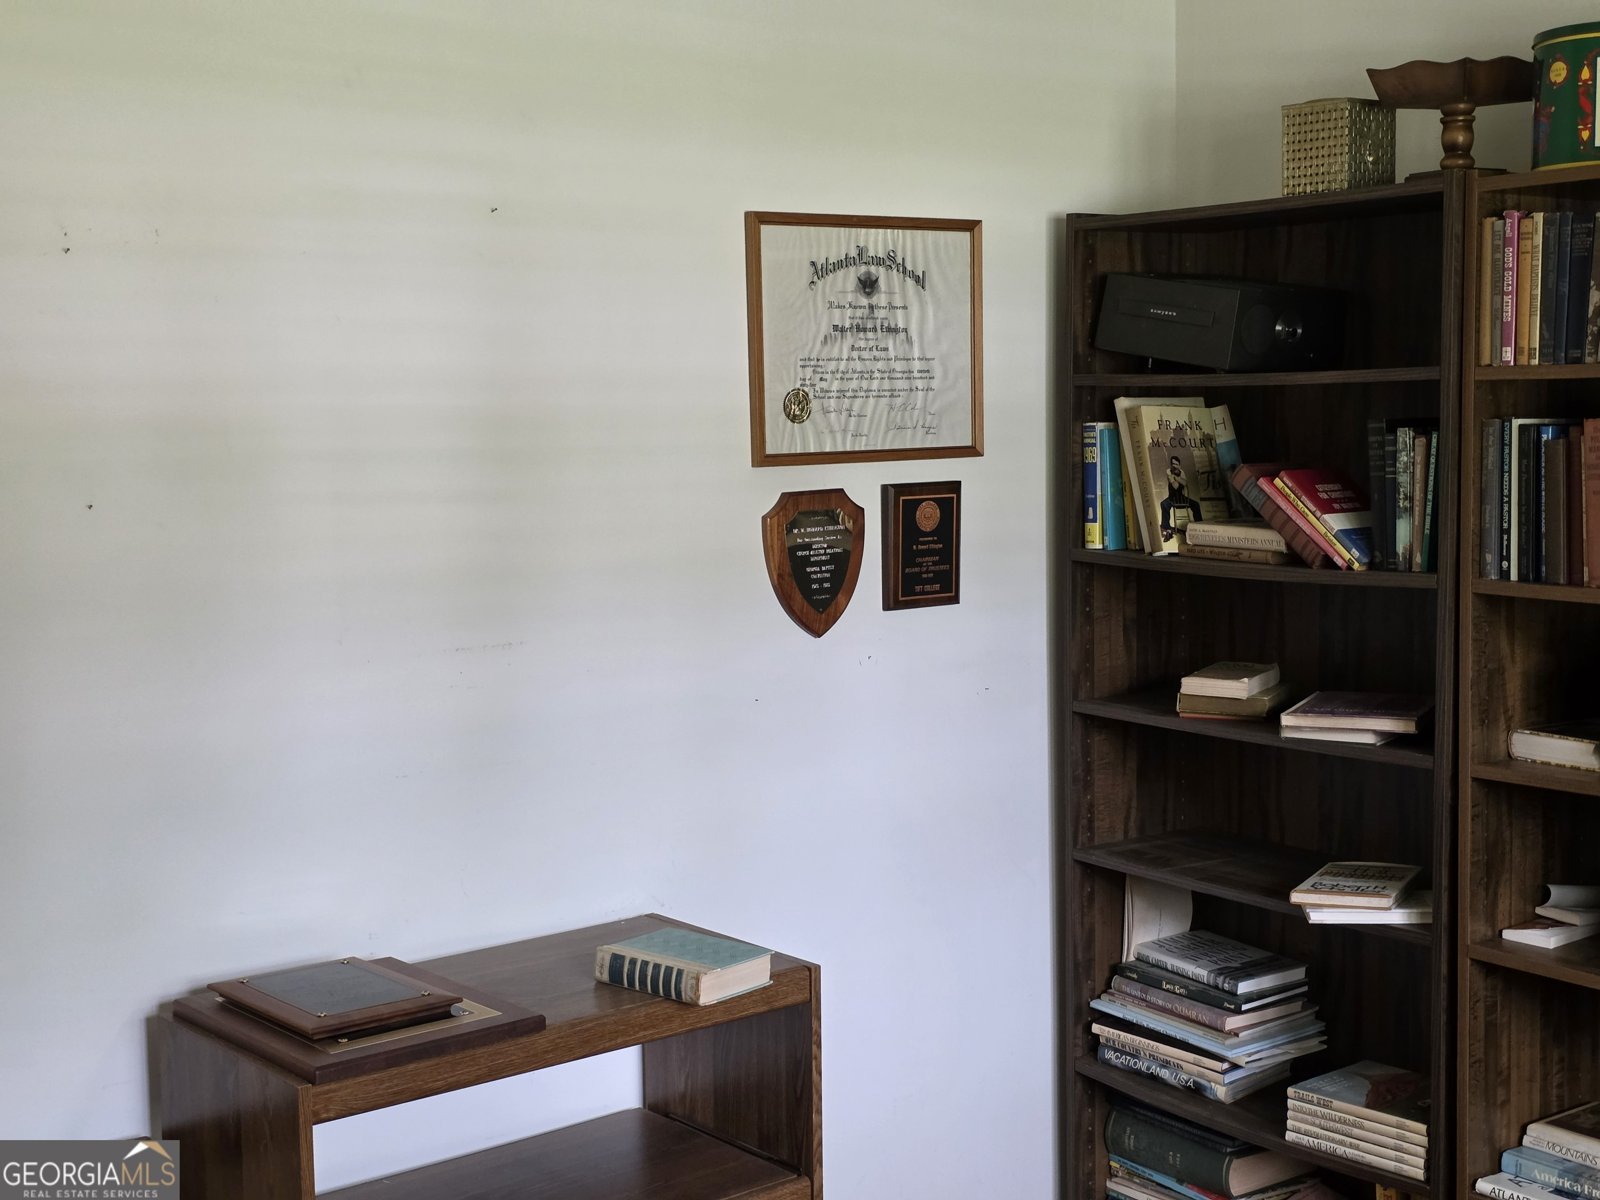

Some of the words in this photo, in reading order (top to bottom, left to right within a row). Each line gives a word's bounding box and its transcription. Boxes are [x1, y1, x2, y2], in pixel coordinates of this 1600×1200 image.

[808, 252, 857, 291] Atlanta
[855, 244, 886, 268] Law
[885, 249, 927, 291] School
[1504, 247, 1513, 268] GOD'S
[1503, 271, 1512, 292] GOLD
[1502, 295, 1512, 322] MINES
[1157, 418, 1203, 431] FRANK
[1151, 436, 1217, 449] McCOURT
[1430, 434, 1438, 455] GREAT
[1084, 446, 1097, 463] 1969
[1427, 456, 1435, 491] QUESTIONS
[1280, 484, 1294, 497] People
[1151, 996, 1165, 1006] STORY
[1172, 1003, 1210, 1024] QUMRAN
[1104, 1048, 1169, 1079] VACATIONLAND
[1172, 1072, 1196, 1090] U.S.A.
[1294, 1090, 1315, 1104] TRAILS
[1316, 1096, 1334, 1108] WEST
[1319, 1110, 1366, 1129] WILDERNESS
[1304, 1138, 1349, 1160] AMERICA
[1544, 1140, 1599, 1166] MOUNTAINS
[1531, 1168, 1582, 1192] America
